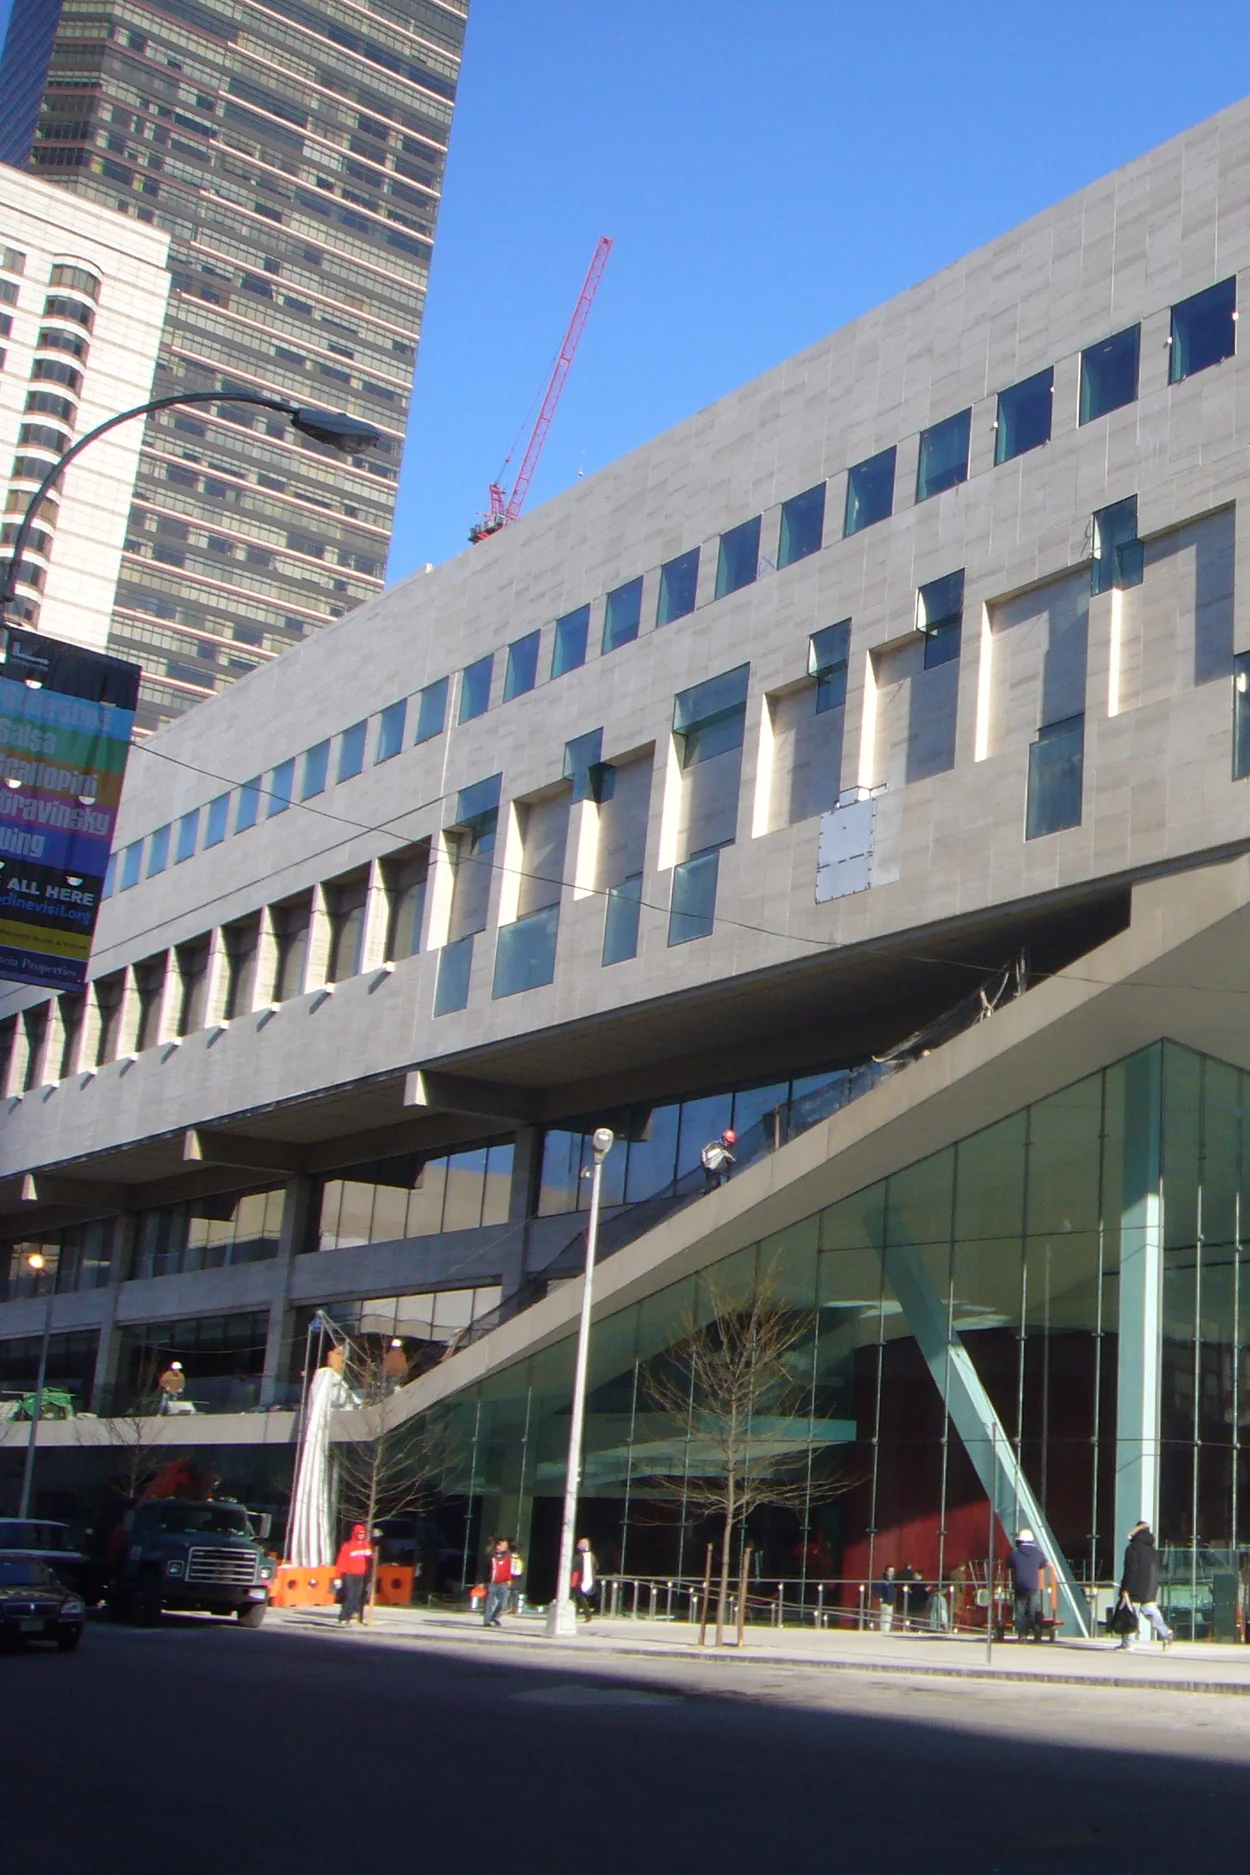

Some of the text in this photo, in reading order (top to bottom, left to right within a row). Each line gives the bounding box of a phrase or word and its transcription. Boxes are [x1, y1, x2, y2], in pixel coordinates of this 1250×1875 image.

[0, 789, 110, 835] travinsky
[7, 877, 95, 906] ALL HERE
